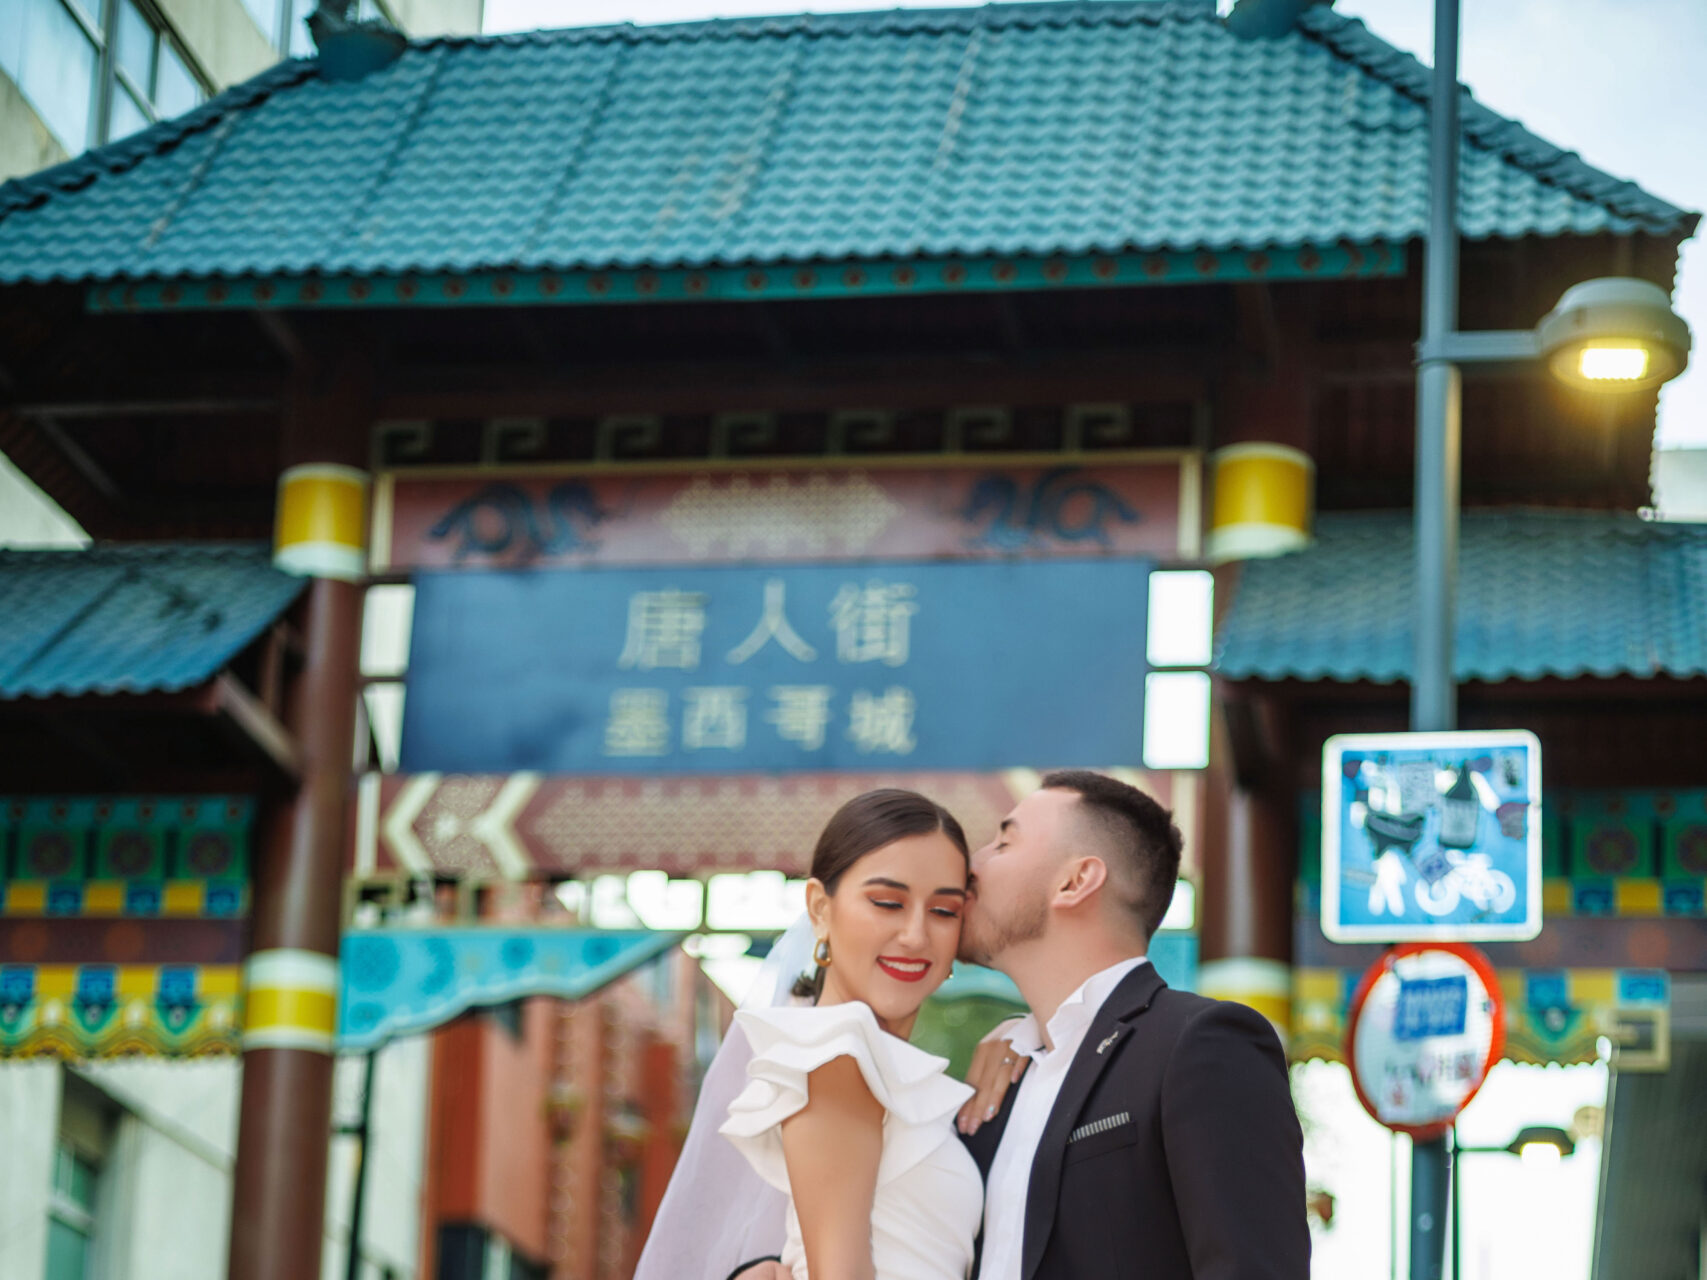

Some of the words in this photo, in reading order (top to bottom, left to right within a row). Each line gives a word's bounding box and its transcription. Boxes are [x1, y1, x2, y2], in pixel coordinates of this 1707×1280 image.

[617, 579, 919, 669] 唐人街
[603, 685, 917, 757] 墨西哥城
